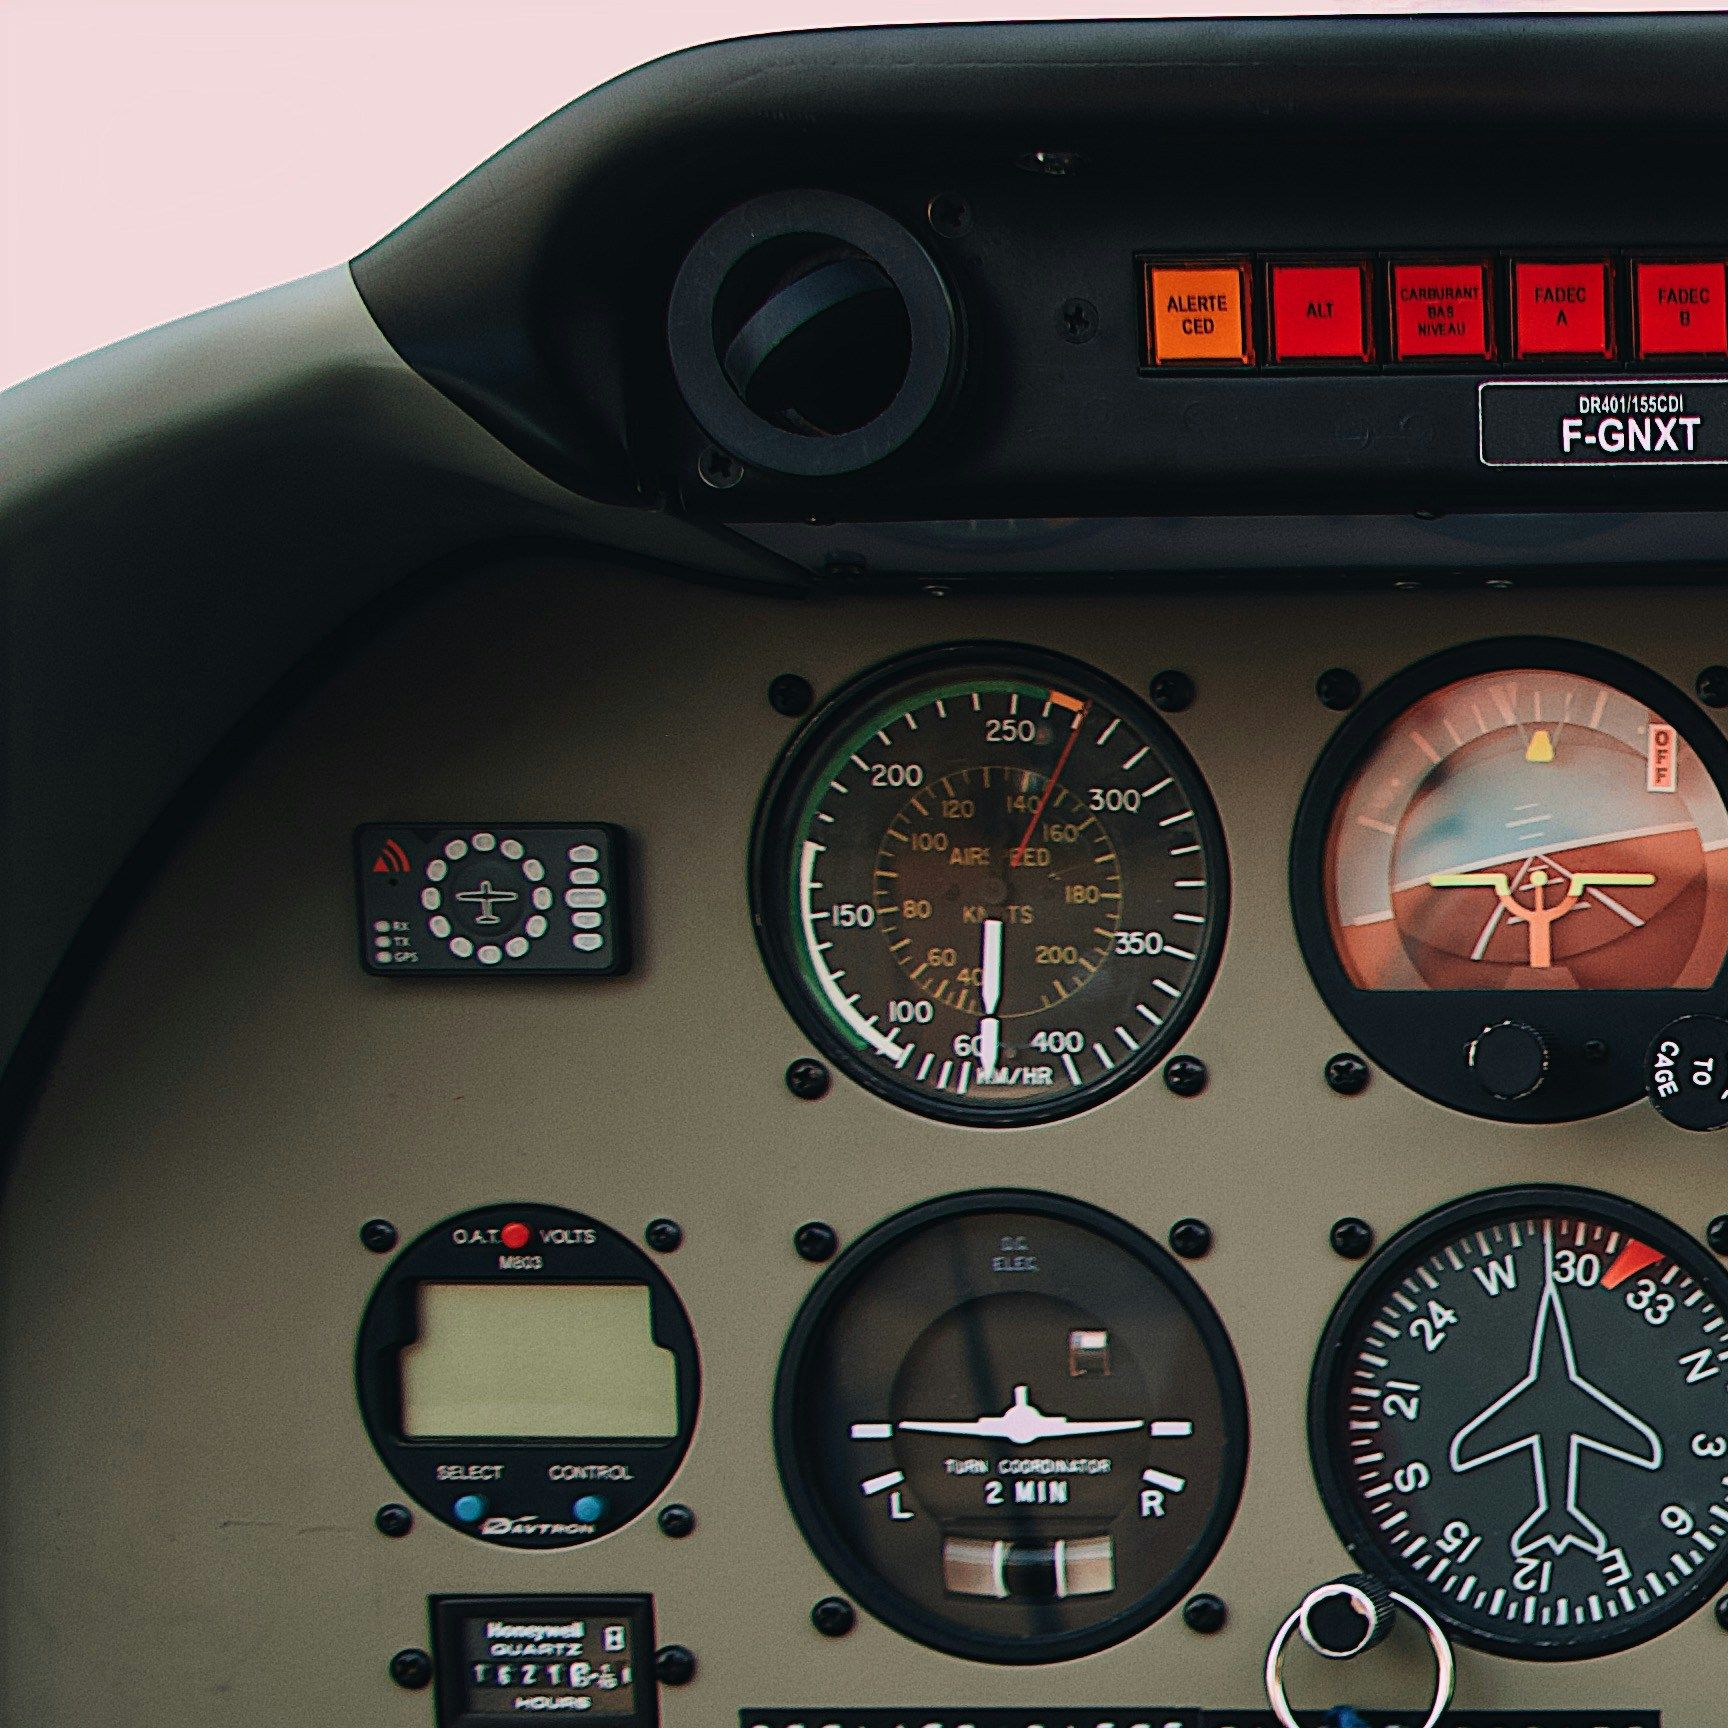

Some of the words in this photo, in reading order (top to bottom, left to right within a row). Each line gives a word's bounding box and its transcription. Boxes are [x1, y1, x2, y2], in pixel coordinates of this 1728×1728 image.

[1167, 296, 1228, 314] ALERTE
[1535, 287, 1587, 305] FADEC
[1658, 287, 1711, 305] FADEC
[1307, 302, 1335, 319] ALT
[1555, 311, 1568, 328] A
[1679, 311, 1690, 327] B
[1182, 318, 1215, 335] CED
[1579, 395, 1684, 415] DR401/155CDI
[1563, 418, 1700, 453] F-GNXT
[986, 720, 1034, 741] 250
[872, 765, 922, 786] 200
[1090, 790, 1140, 811] 300
[832, 906, 874, 927] 150
[1114, 932, 1163, 954] 350
[1652, 1041, 1680, 1098] CAGE
[1693, 1059, 1712, 1085] TO
[540, 1230, 596, 1244] VOLTS
[1474, 1255, 1517, 1295] W
[1552, 1251, 1599, 1286] 30
[437, 1466, 503, 1480] SELECT
[549, 1466, 634, 1480] CONTROL
[945, 1459, 988, 1473] TURN
[999, 1459, 1111, 1474] COORDINATOR
[985, 1482, 1004, 1504] 2
[1015, 1481, 1067, 1504] MIN
[491, 1644, 583, 1657] QUARTZ
[514, 1697, 592, 1710] HOURS
